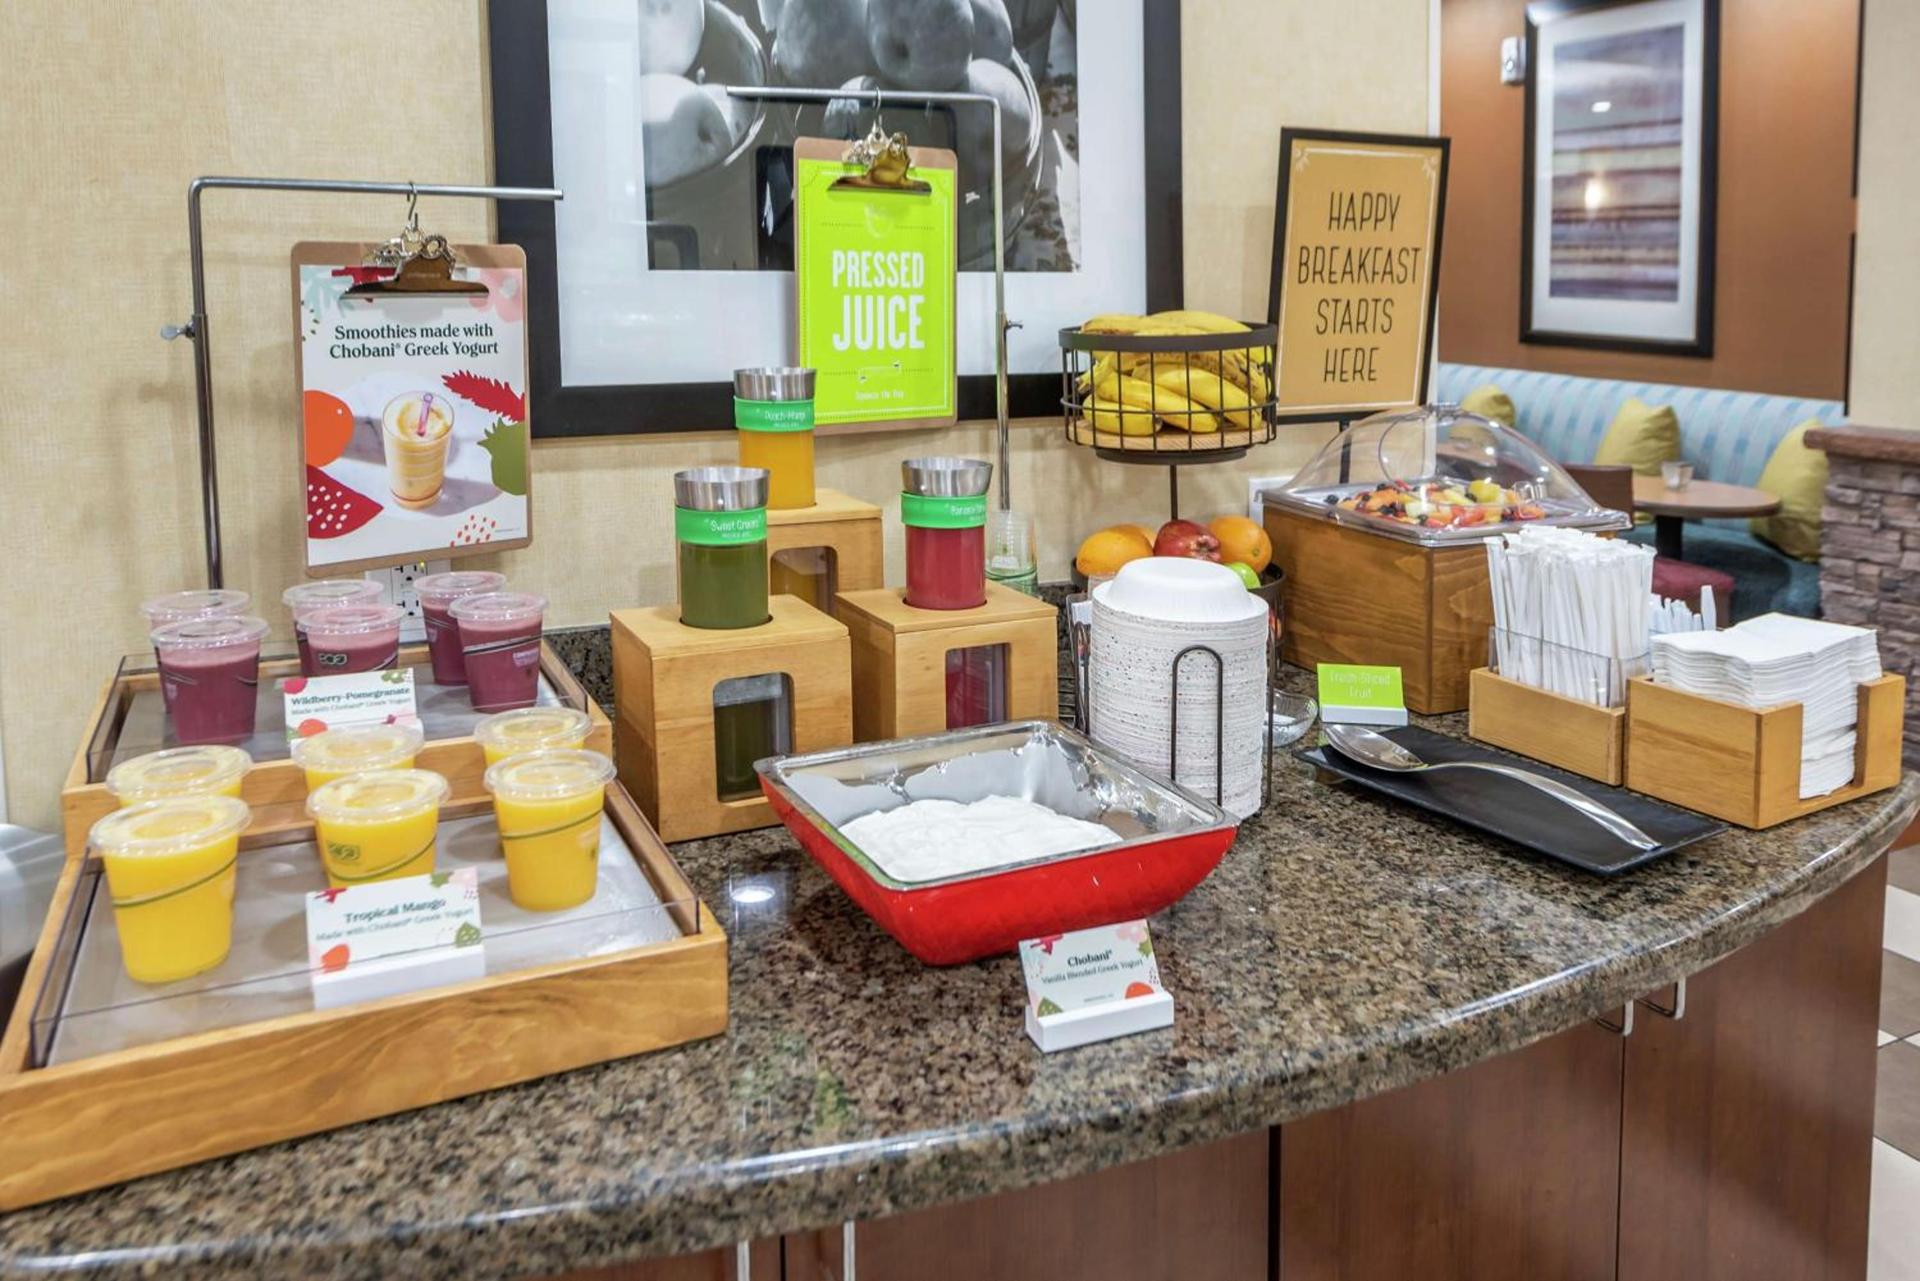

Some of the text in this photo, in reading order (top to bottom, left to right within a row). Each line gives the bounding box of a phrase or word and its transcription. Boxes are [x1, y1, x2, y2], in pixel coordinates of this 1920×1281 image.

[1328, 191, 1401, 233] HAPPY
[832, 250, 924, 288] PRESSED
[1297, 246, 1421, 285] BREAKFAST
[334, 323, 494, 340] Smoothies made with
[833, 295, 925, 351] JUICE
[1315, 298, 1395, 335] STARTS
[404, 342, 449, 356] Greek
[453, 342, 498, 358] Yogurt
[1323, 347, 1379, 383] HERE
[343, 898, 446, 924] Tropical Mango
[1040, 958, 1144, 985] Vanilla Blended Greek Yogurt
